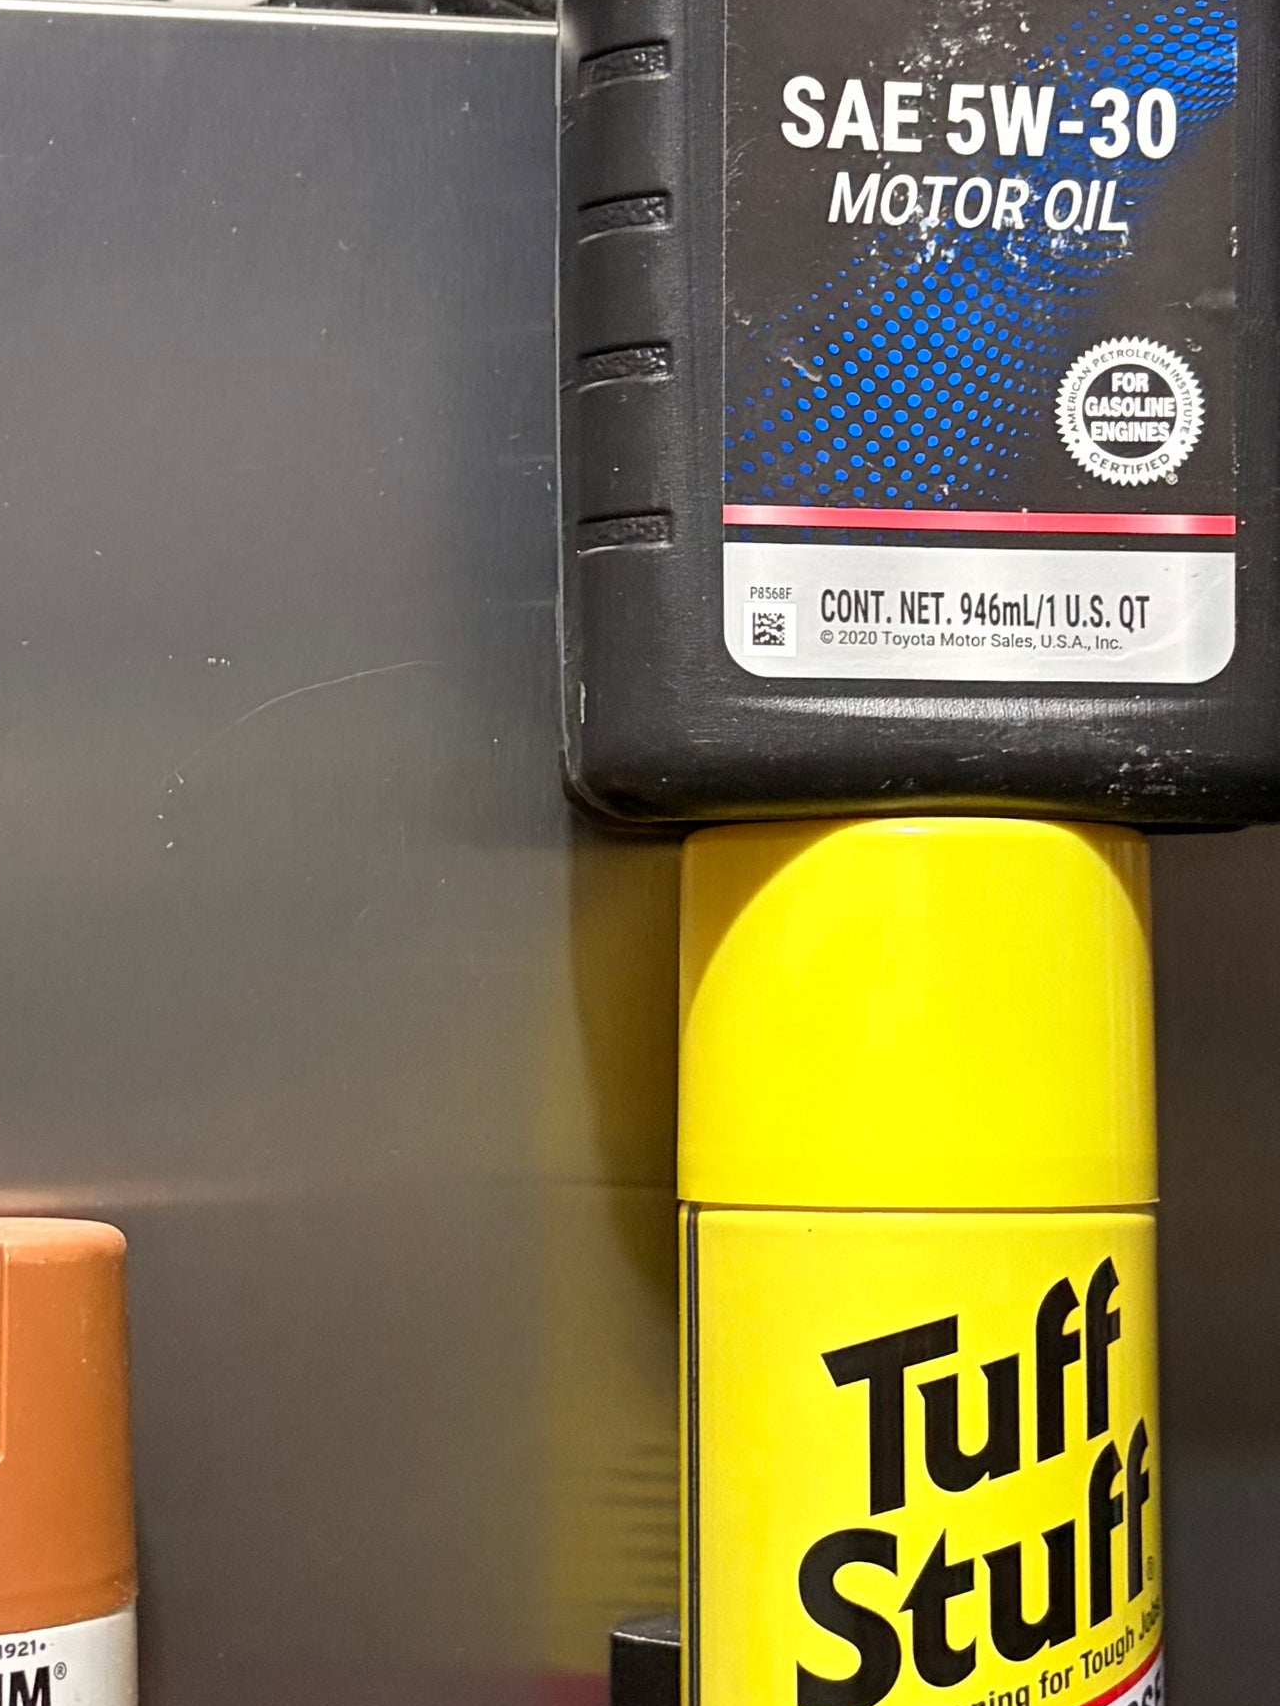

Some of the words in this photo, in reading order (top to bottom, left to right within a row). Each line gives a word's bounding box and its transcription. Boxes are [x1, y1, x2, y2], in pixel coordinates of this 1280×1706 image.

[781, 75, 923, 154] SAE
[946, 82, 1178, 160] 5W-30
[828, 171, 1030, 231] MOTOR
[1043, 179, 1130, 233] OIL
[1067, 366, 1092, 433] AMERICAN
[1091, 348, 1172, 371] PETROLEUM
[1169, 368, 1194, 435] INSTITUTE
[1111, 371, 1150, 394] FOR
[1084, 395, 1176, 418] GASOLINE
[1090, 420, 1171, 443] ENGINES
[1089, 451, 1170, 475] CERTIFIED
[820, 588, 893, 624] CONT.
[900, 590, 953, 625] NET.
[960, 591, 1056, 630] 946mL/1
[1065, 593, 1112, 628] U.S.
[1119, 594, 1151, 634] QT
[838, 630, 878, 646] 2020
[881, 630, 936, 650] Toyota
[939, 632, 987, 648] Motor
[990, 632, 1037, 651] Sales,
[1040, 634, 1091, 652] U.S.A.,
[1095, 634, 1124, 651] Inc.
[821, 1254, 1121, 1517] Tuff
[1039, 1665, 1074, 1700] for
[1080, 1625, 1135, 1681] Tough
